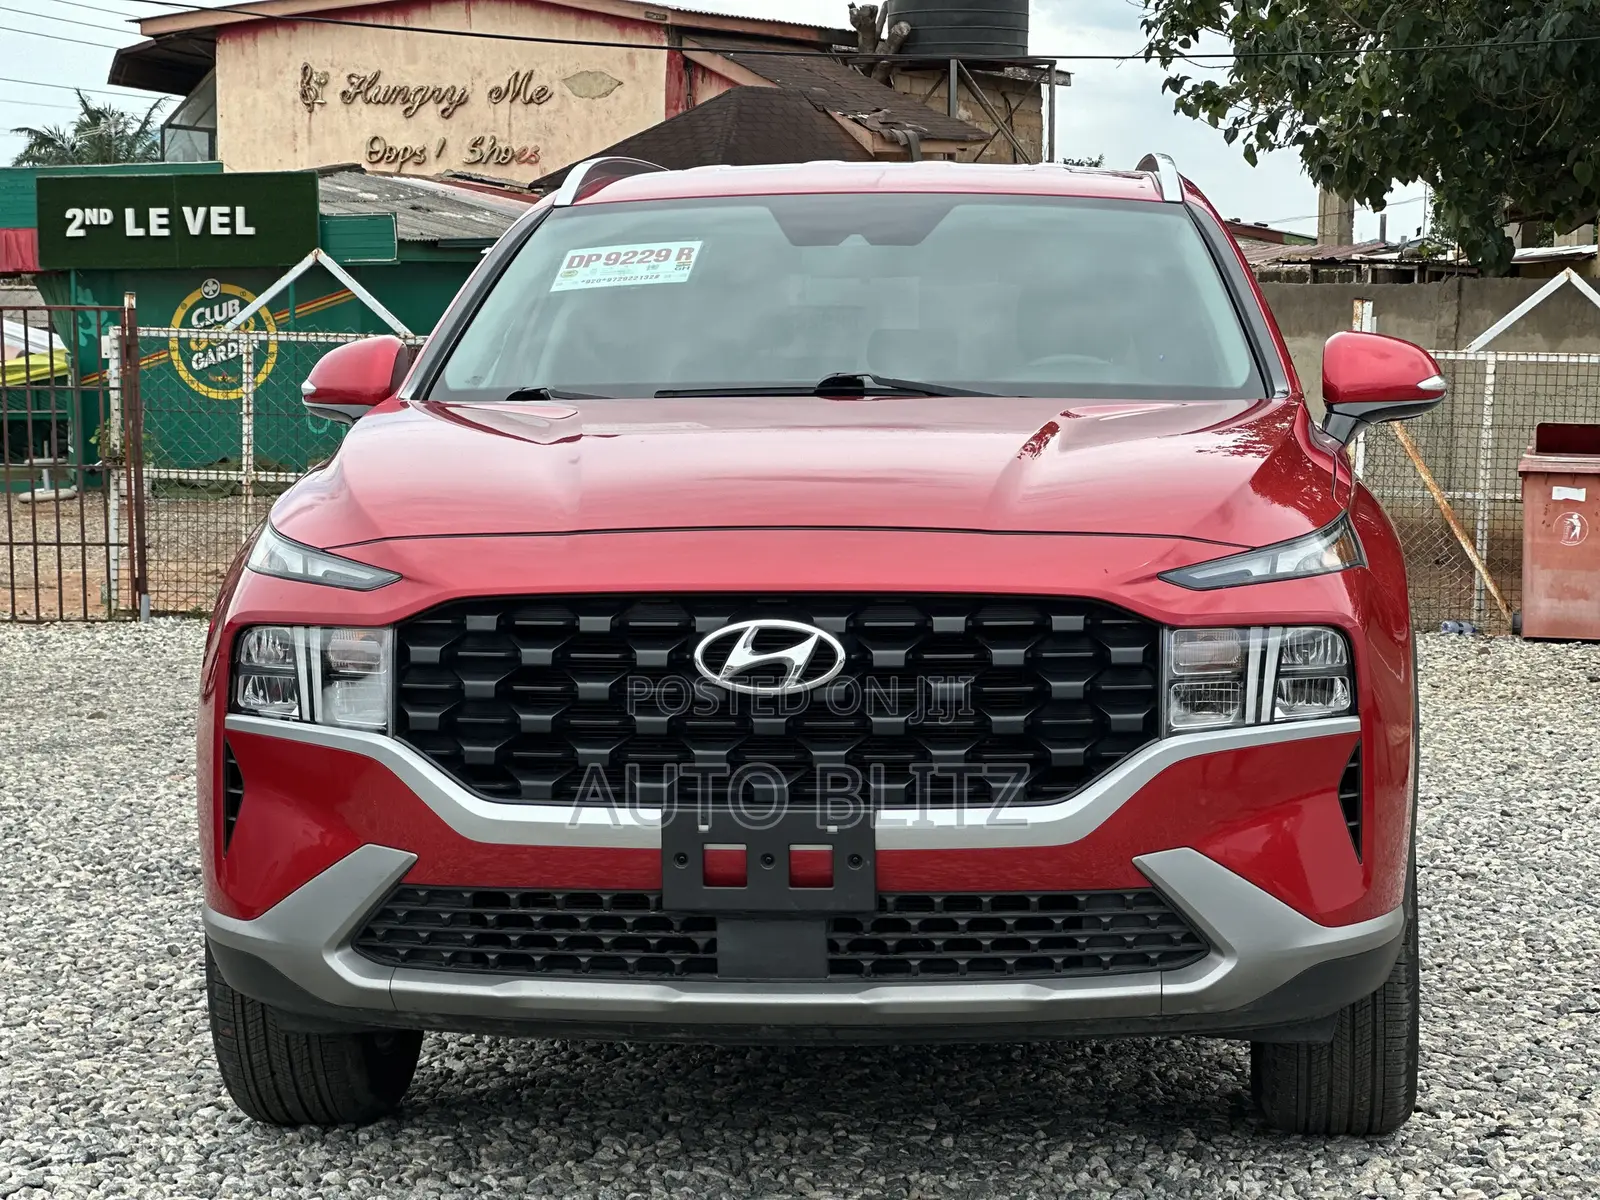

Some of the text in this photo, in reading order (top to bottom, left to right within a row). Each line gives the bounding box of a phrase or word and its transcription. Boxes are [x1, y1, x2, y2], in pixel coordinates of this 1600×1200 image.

[340, 69, 553, 120] Hungry Me
[463, 135, 541, 165] Shoes
[65, 207, 114, 237] 2ND
[565, 247, 695, 270] DP 9229 R
[191, 299, 240, 328] CLUB
